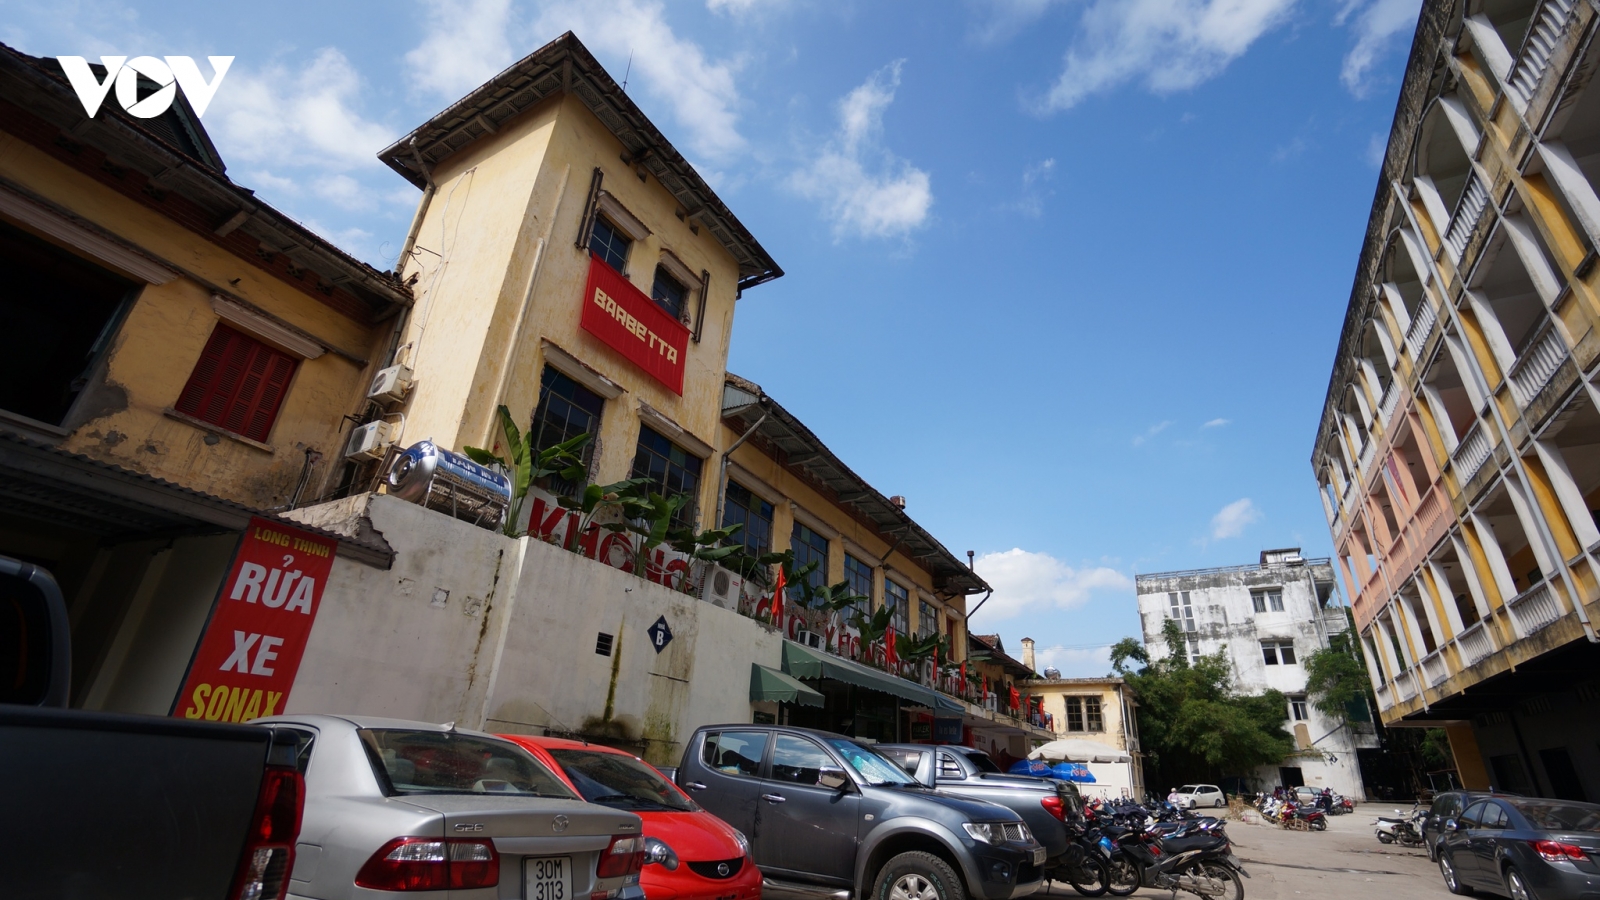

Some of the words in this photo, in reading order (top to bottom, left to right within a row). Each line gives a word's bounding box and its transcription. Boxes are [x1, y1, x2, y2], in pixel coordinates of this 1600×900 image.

[594, 286, 678, 366] BARBETTA
[254, 526, 291, 548] LONG
[293, 537, 330, 559] THỊNH
[230, 554, 316, 616] RỬA
[219, 629, 285, 677] XE
[656, 630, 664, 646] B
[185, 683, 283, 725] SONAX
[536, 860, 563, 880] 30M
[536, 880, 563, 900] 3113
